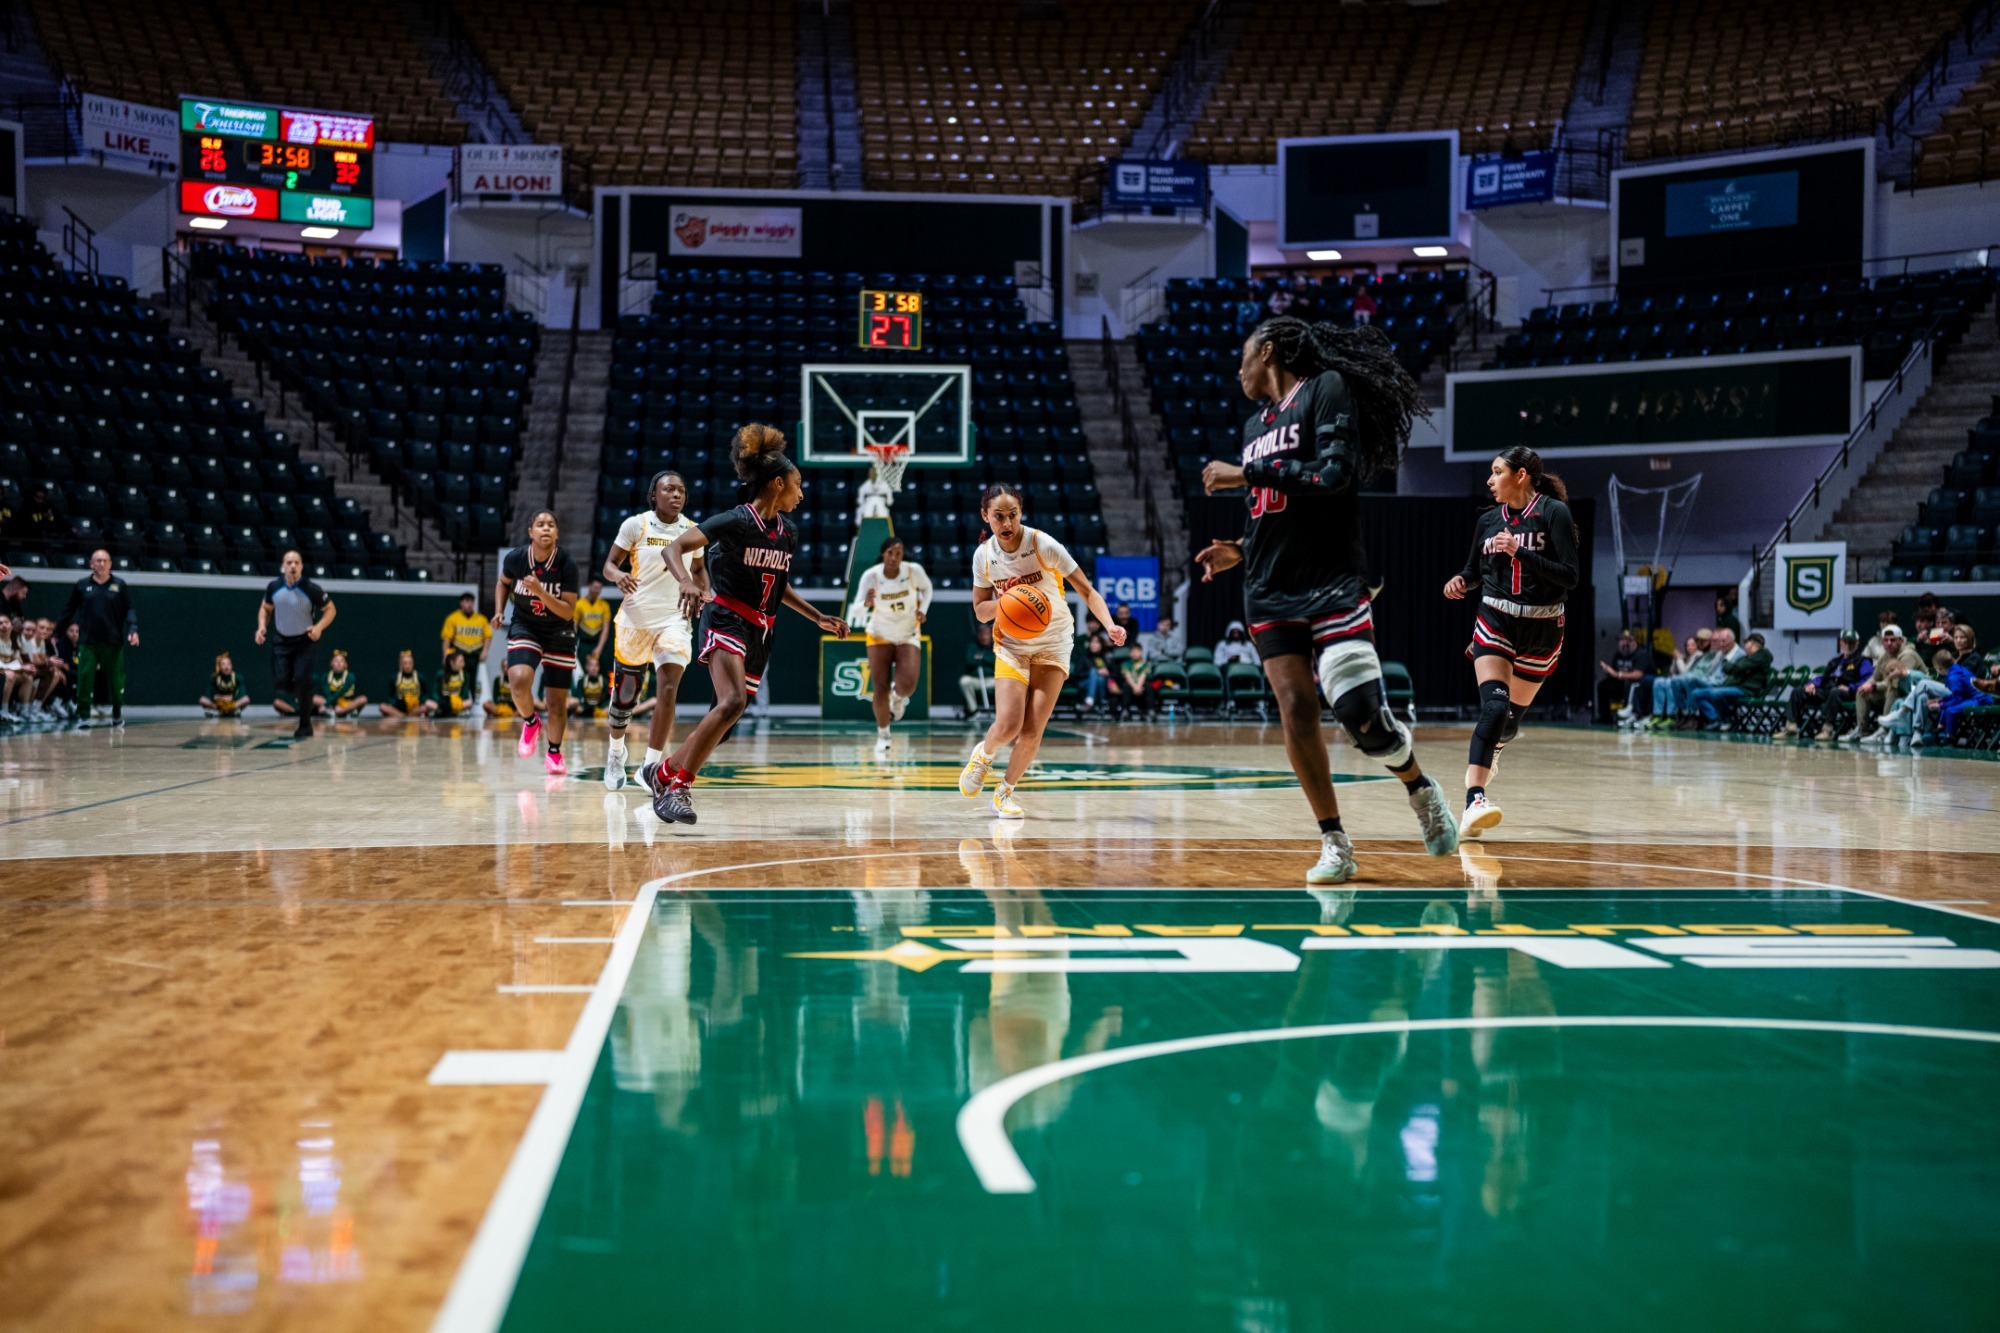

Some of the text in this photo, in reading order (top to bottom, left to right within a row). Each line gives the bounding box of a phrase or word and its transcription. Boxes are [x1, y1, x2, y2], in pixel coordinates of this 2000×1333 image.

[105, 131, 168, 158] LIKE...
[261, 144, 310, 168] 3:58
[201, 149, 226, 171] 26
[286, 171, 298, 189] 2
[336, 163, 360, 184] 32
[474, 175, 551, 191] A LION!
[306, 207, 347, 222] LIGHT
[312, 197, 342, 210] BUD
[871, 314, 910, 347] 27
[743, 547, 793, 573] NICHOLLS
[1098, 576, 1156, 601] FGB
[1510, 557, 1522, 595] 1
[1797, 567, 1822, 598] S
[759, 573, 775, 612] 7
[1016, 587, 1046, 616] Wilson
